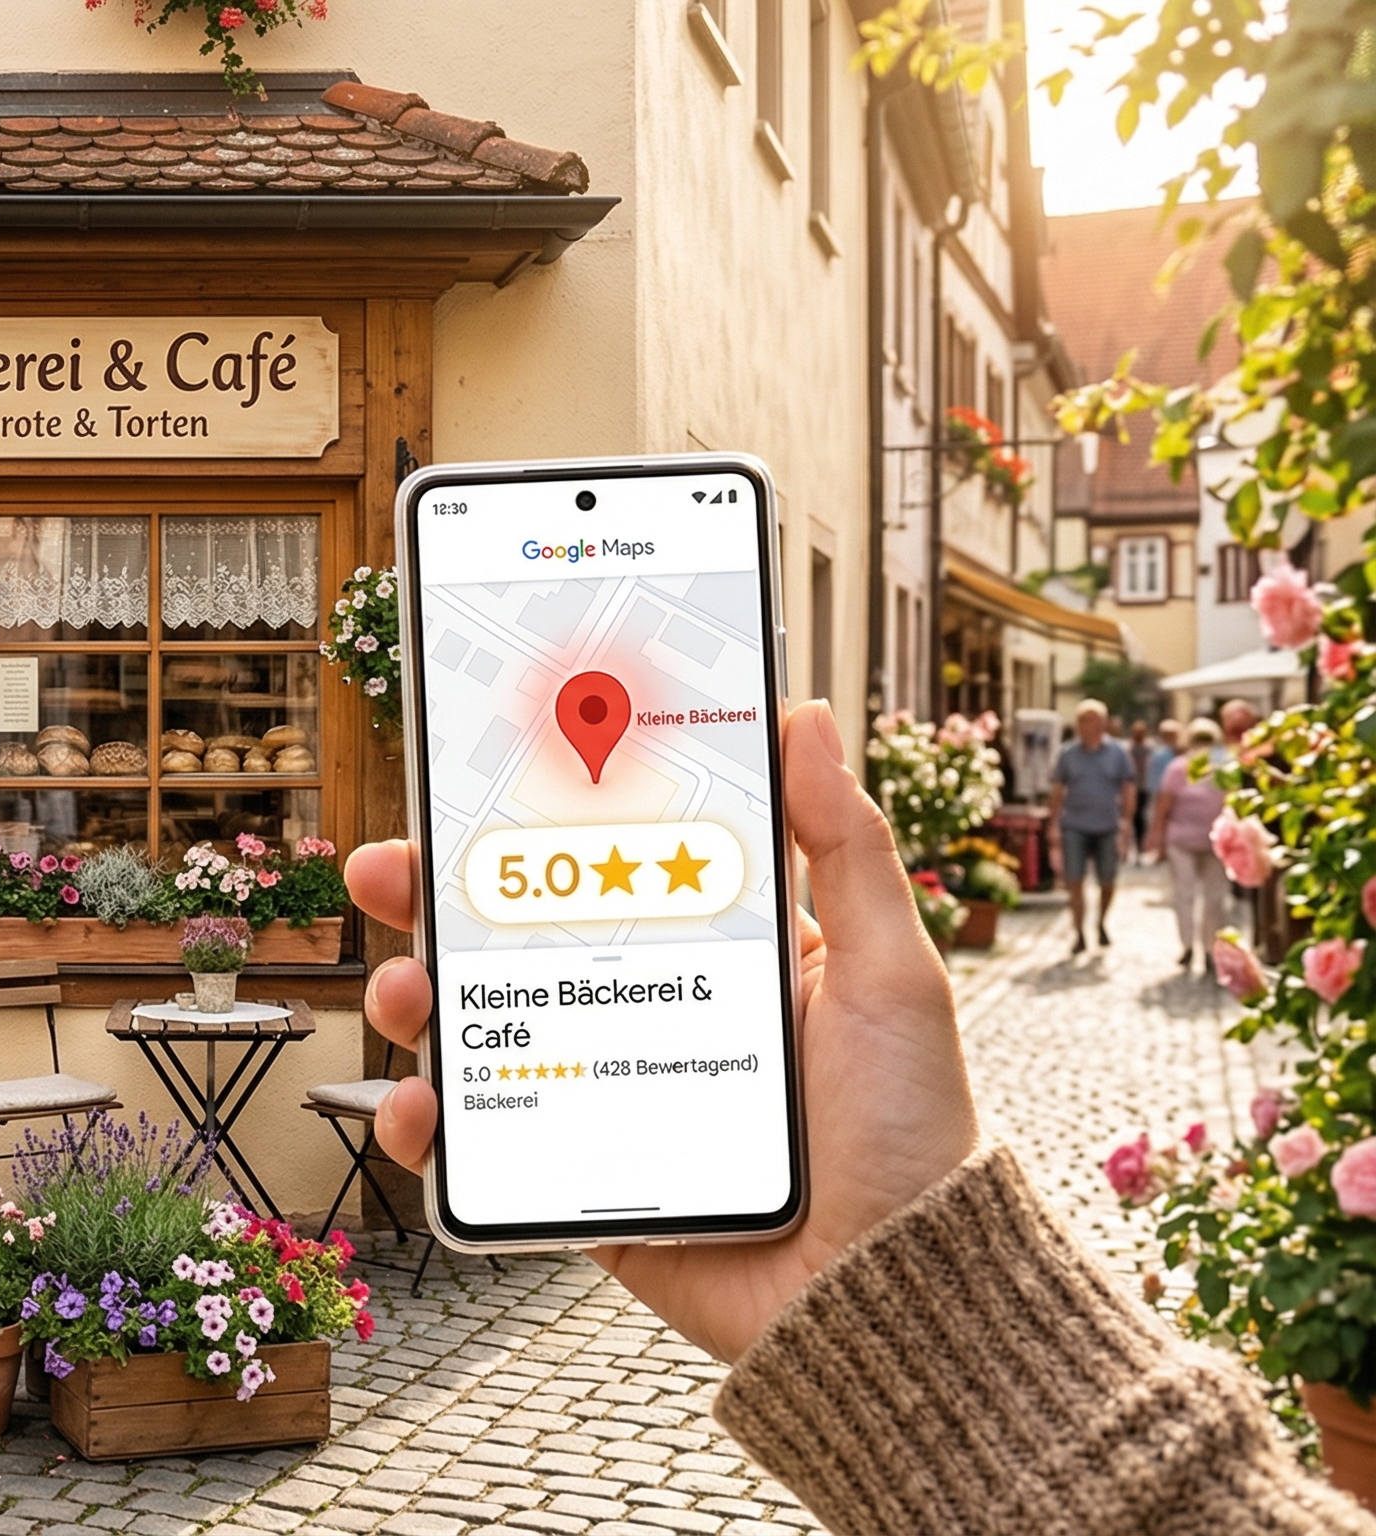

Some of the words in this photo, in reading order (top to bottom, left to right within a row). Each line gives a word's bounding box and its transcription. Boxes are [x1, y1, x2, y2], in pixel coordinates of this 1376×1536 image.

[103, 338, 148, 392] &
[166, 331, 297, 408] Café
[73, 407, 99, 438] &
[107, 405, 209, 438] Torten
[432, 502, 468, 516] 12:30
[521, 538, 596, 564] Google
[602, 538, 655, 560] Maps
[636, 710, 685, 727] Kleine
[689, 706, 757, 725] Bäckerei
[499, 852, 581, 900] 5.0
[460, 982, 550, 1010] Kleine
[558, 975, 683, 1006] Bäckerei
[692, 974, 713, 1001] &
[461, 1021, 531, 1050] Café
[463, 1066, 491, 1083] 5.0
[593, 1060, 631, 1080] (428
[636, 1053, 759, 1077] Bewertagend)
[464, 1091, 538, 1111] Bäckerei
